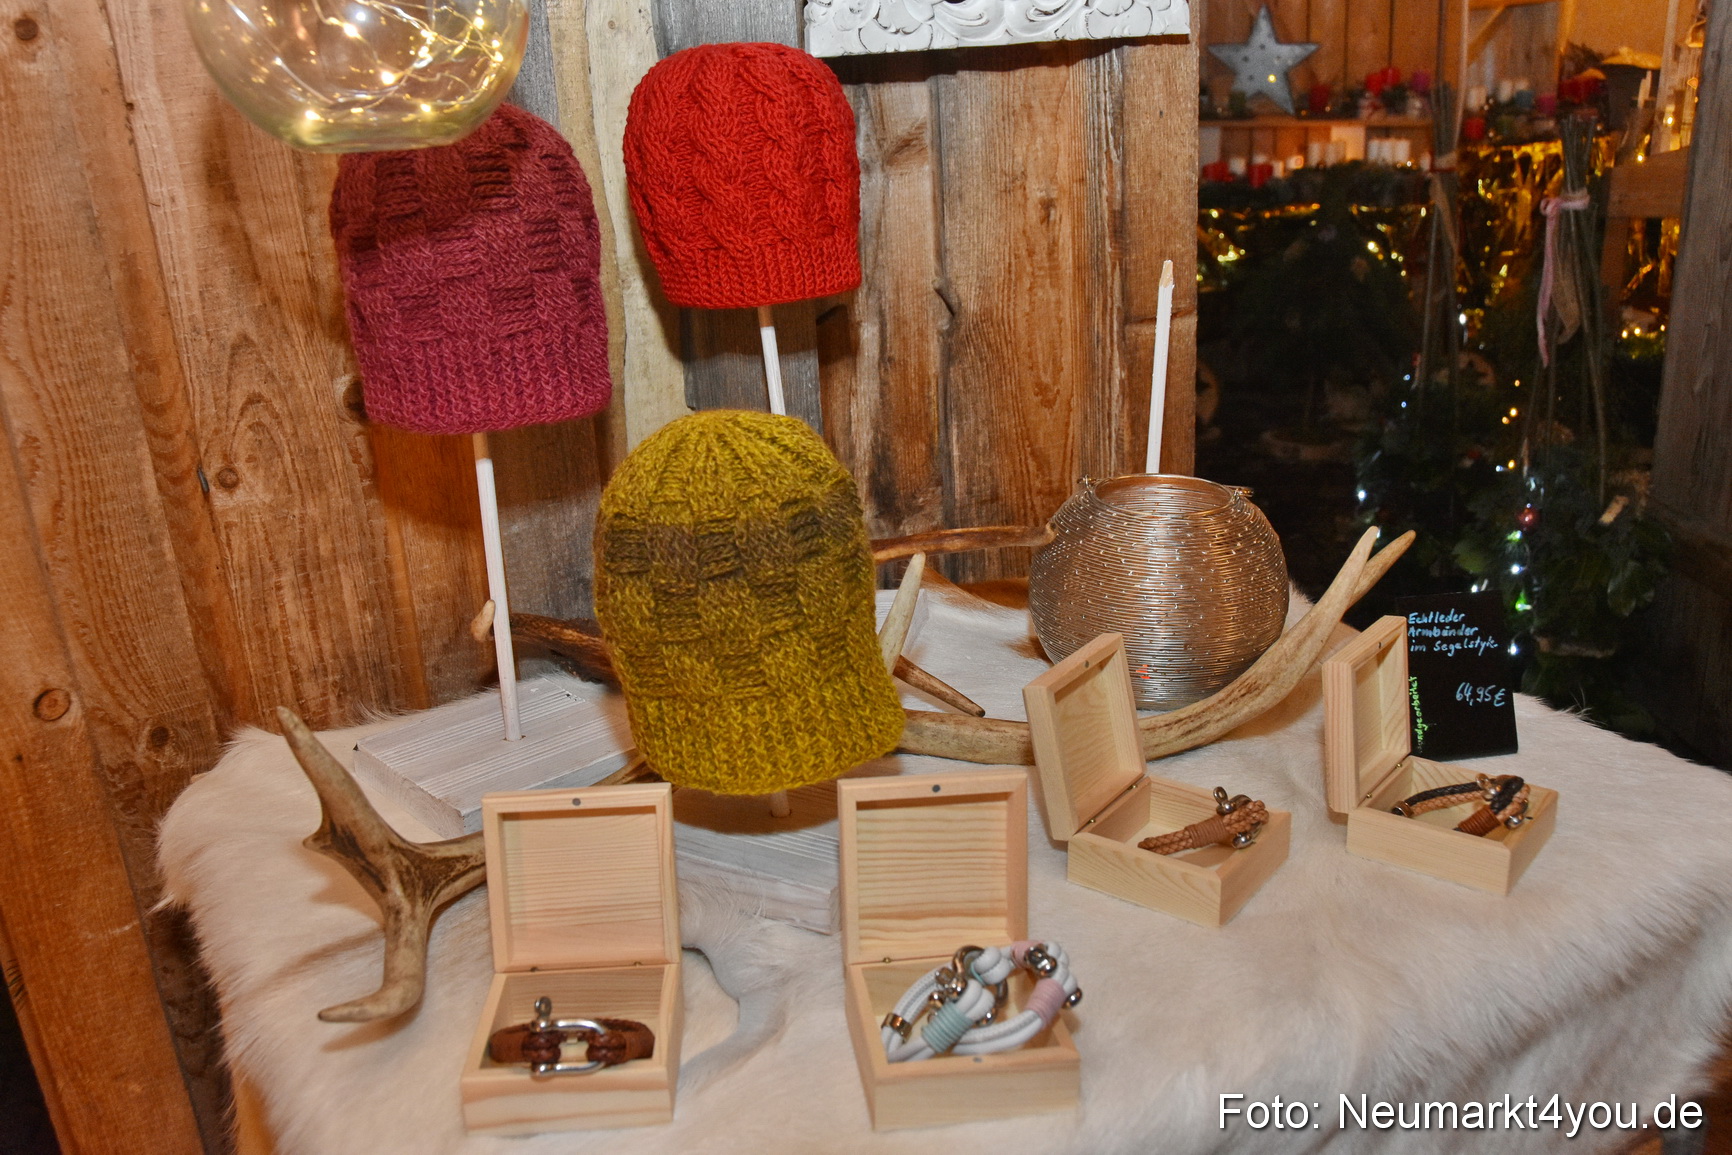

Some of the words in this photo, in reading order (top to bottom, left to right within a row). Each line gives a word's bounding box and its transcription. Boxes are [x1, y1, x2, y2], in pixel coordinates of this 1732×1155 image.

[1407, 607, 1466, 624] Echtleder
[1407, 623, 1479, 638] Armbänder
[1410, 639, 1427, 652] im
[1455, 682, 1506, 707] 64,95€
